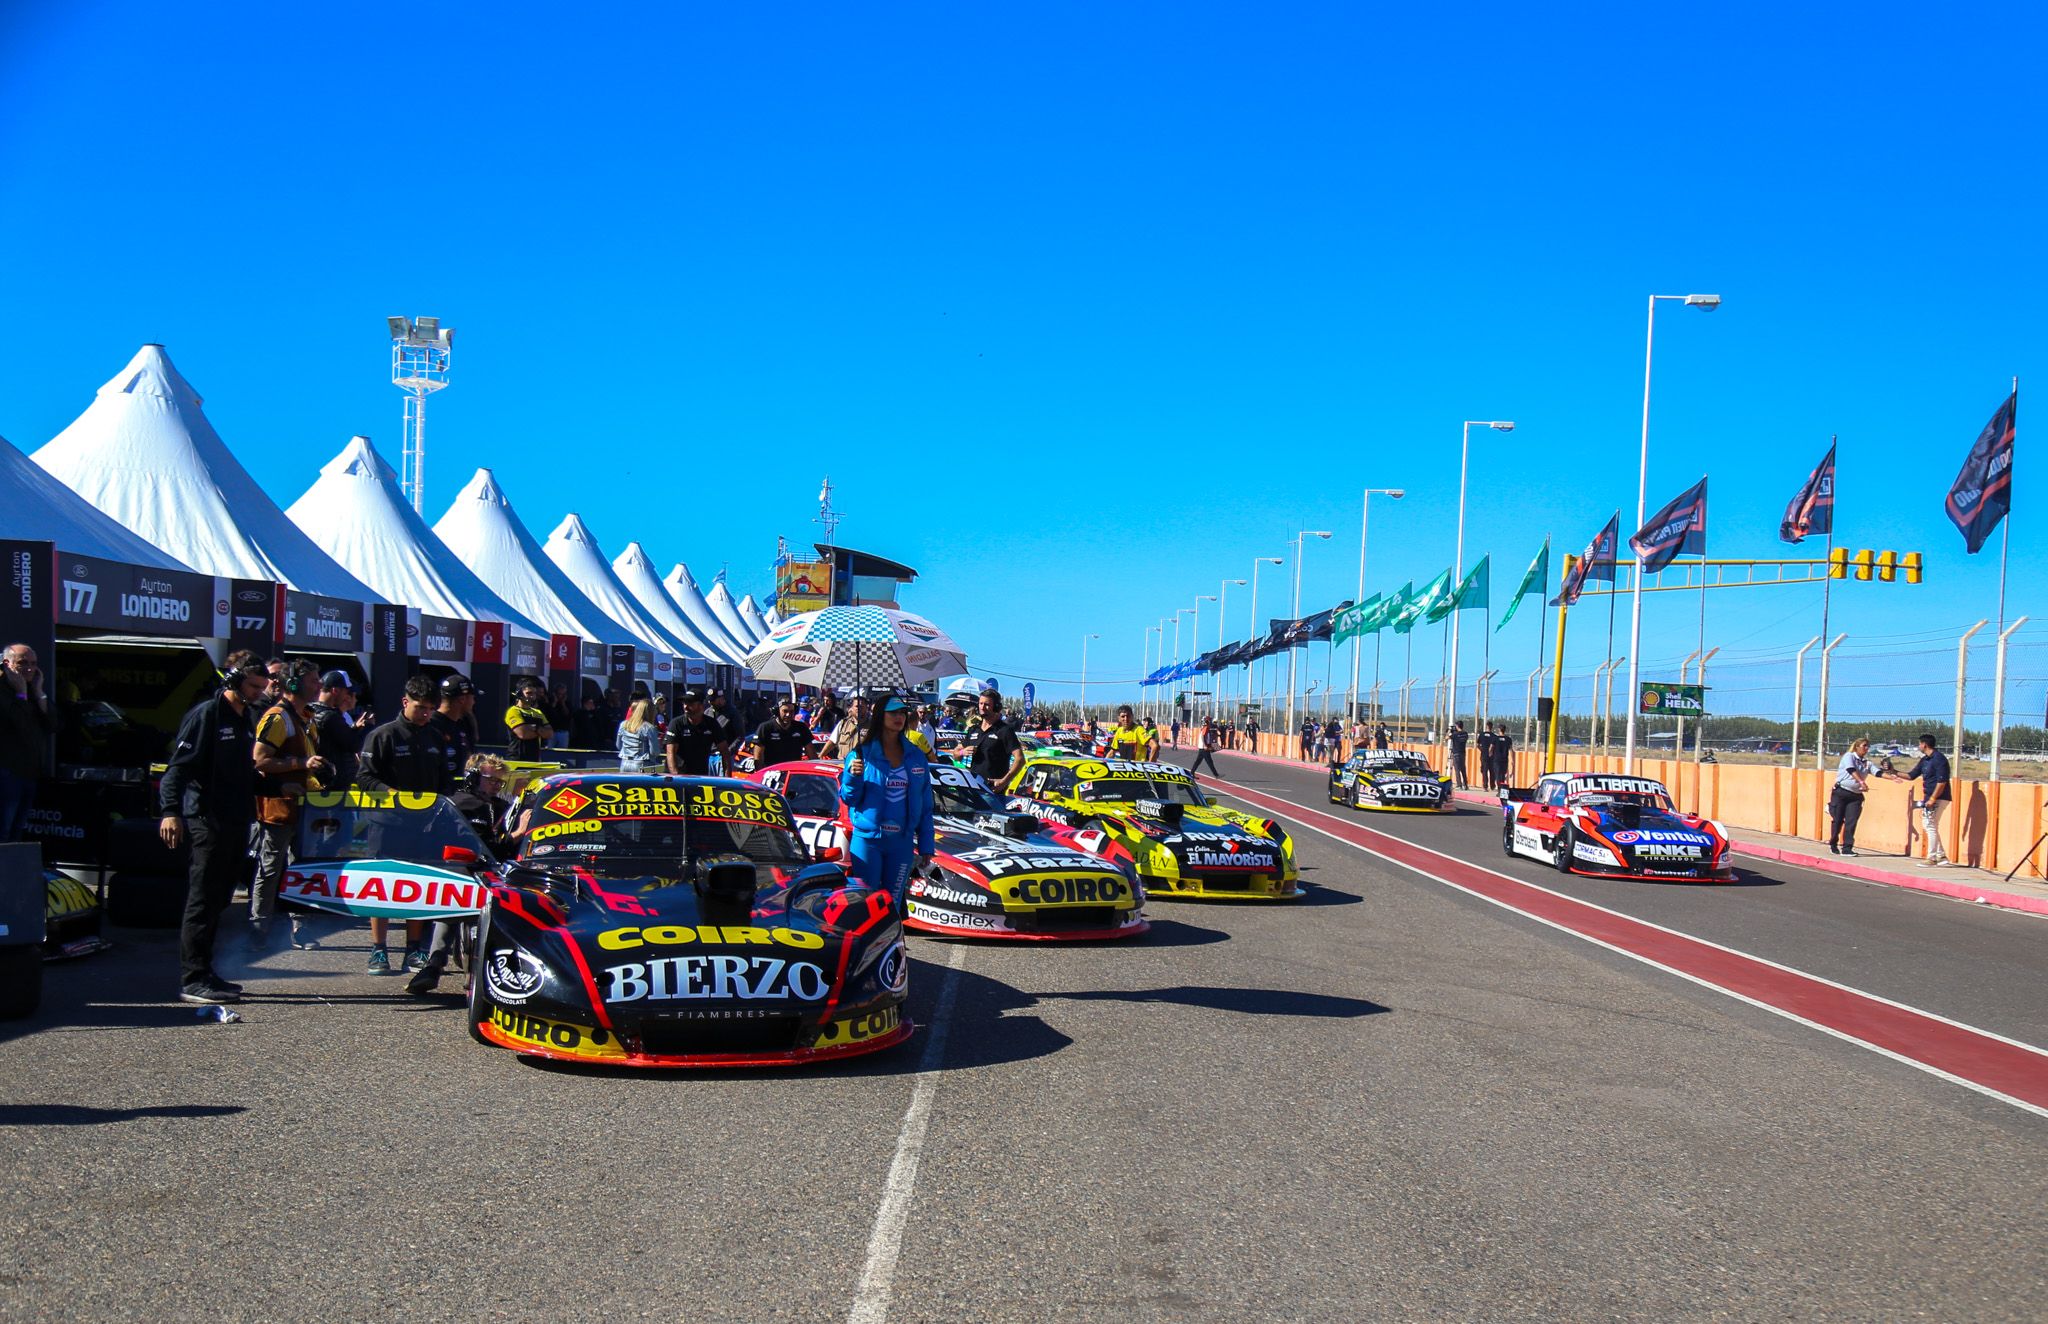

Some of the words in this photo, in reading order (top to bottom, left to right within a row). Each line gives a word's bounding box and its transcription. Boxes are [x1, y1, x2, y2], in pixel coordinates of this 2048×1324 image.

[13, 551, 21, 587] Ayrton
[22, 552, 31, 608] LONDERO
[140, 578, 172, 594] Ayrton
[63, 580, 98, 614] 177
[121, 594, 190, 622] LONDERO
[235, 616, 267, 630] 177
[1665, 699, 1702, 709] HELIX
[595, 783, 679, 804] San
[693, 785, 783, 813] José
[1567, 778, 1669, 797] MULTIBANDAS
[298, 791, 437, 810] OIRO
[557, 796, 577, 810] SJ
[26, 809, 62, 821] anco
[597, 803, 788, 827] SUPERMERCADOS
[531, 819, 602, 841] COIRO
[1635, 830, 1711, 845] Venturi
[1635, 844, 1702, 856] FINKE
[980, 855, 1121, 876] Piazza
[278, 870, 491, 910] PALADINI
[1018, 877, 1121, 903] COIRO
[917, 907, 995, 928] megaflex
[598, 926, 825, 950] COIRO
[605, 956, 830, 1003] BIERZO
[677, 1010, 766, 1020] FIAMBRES
